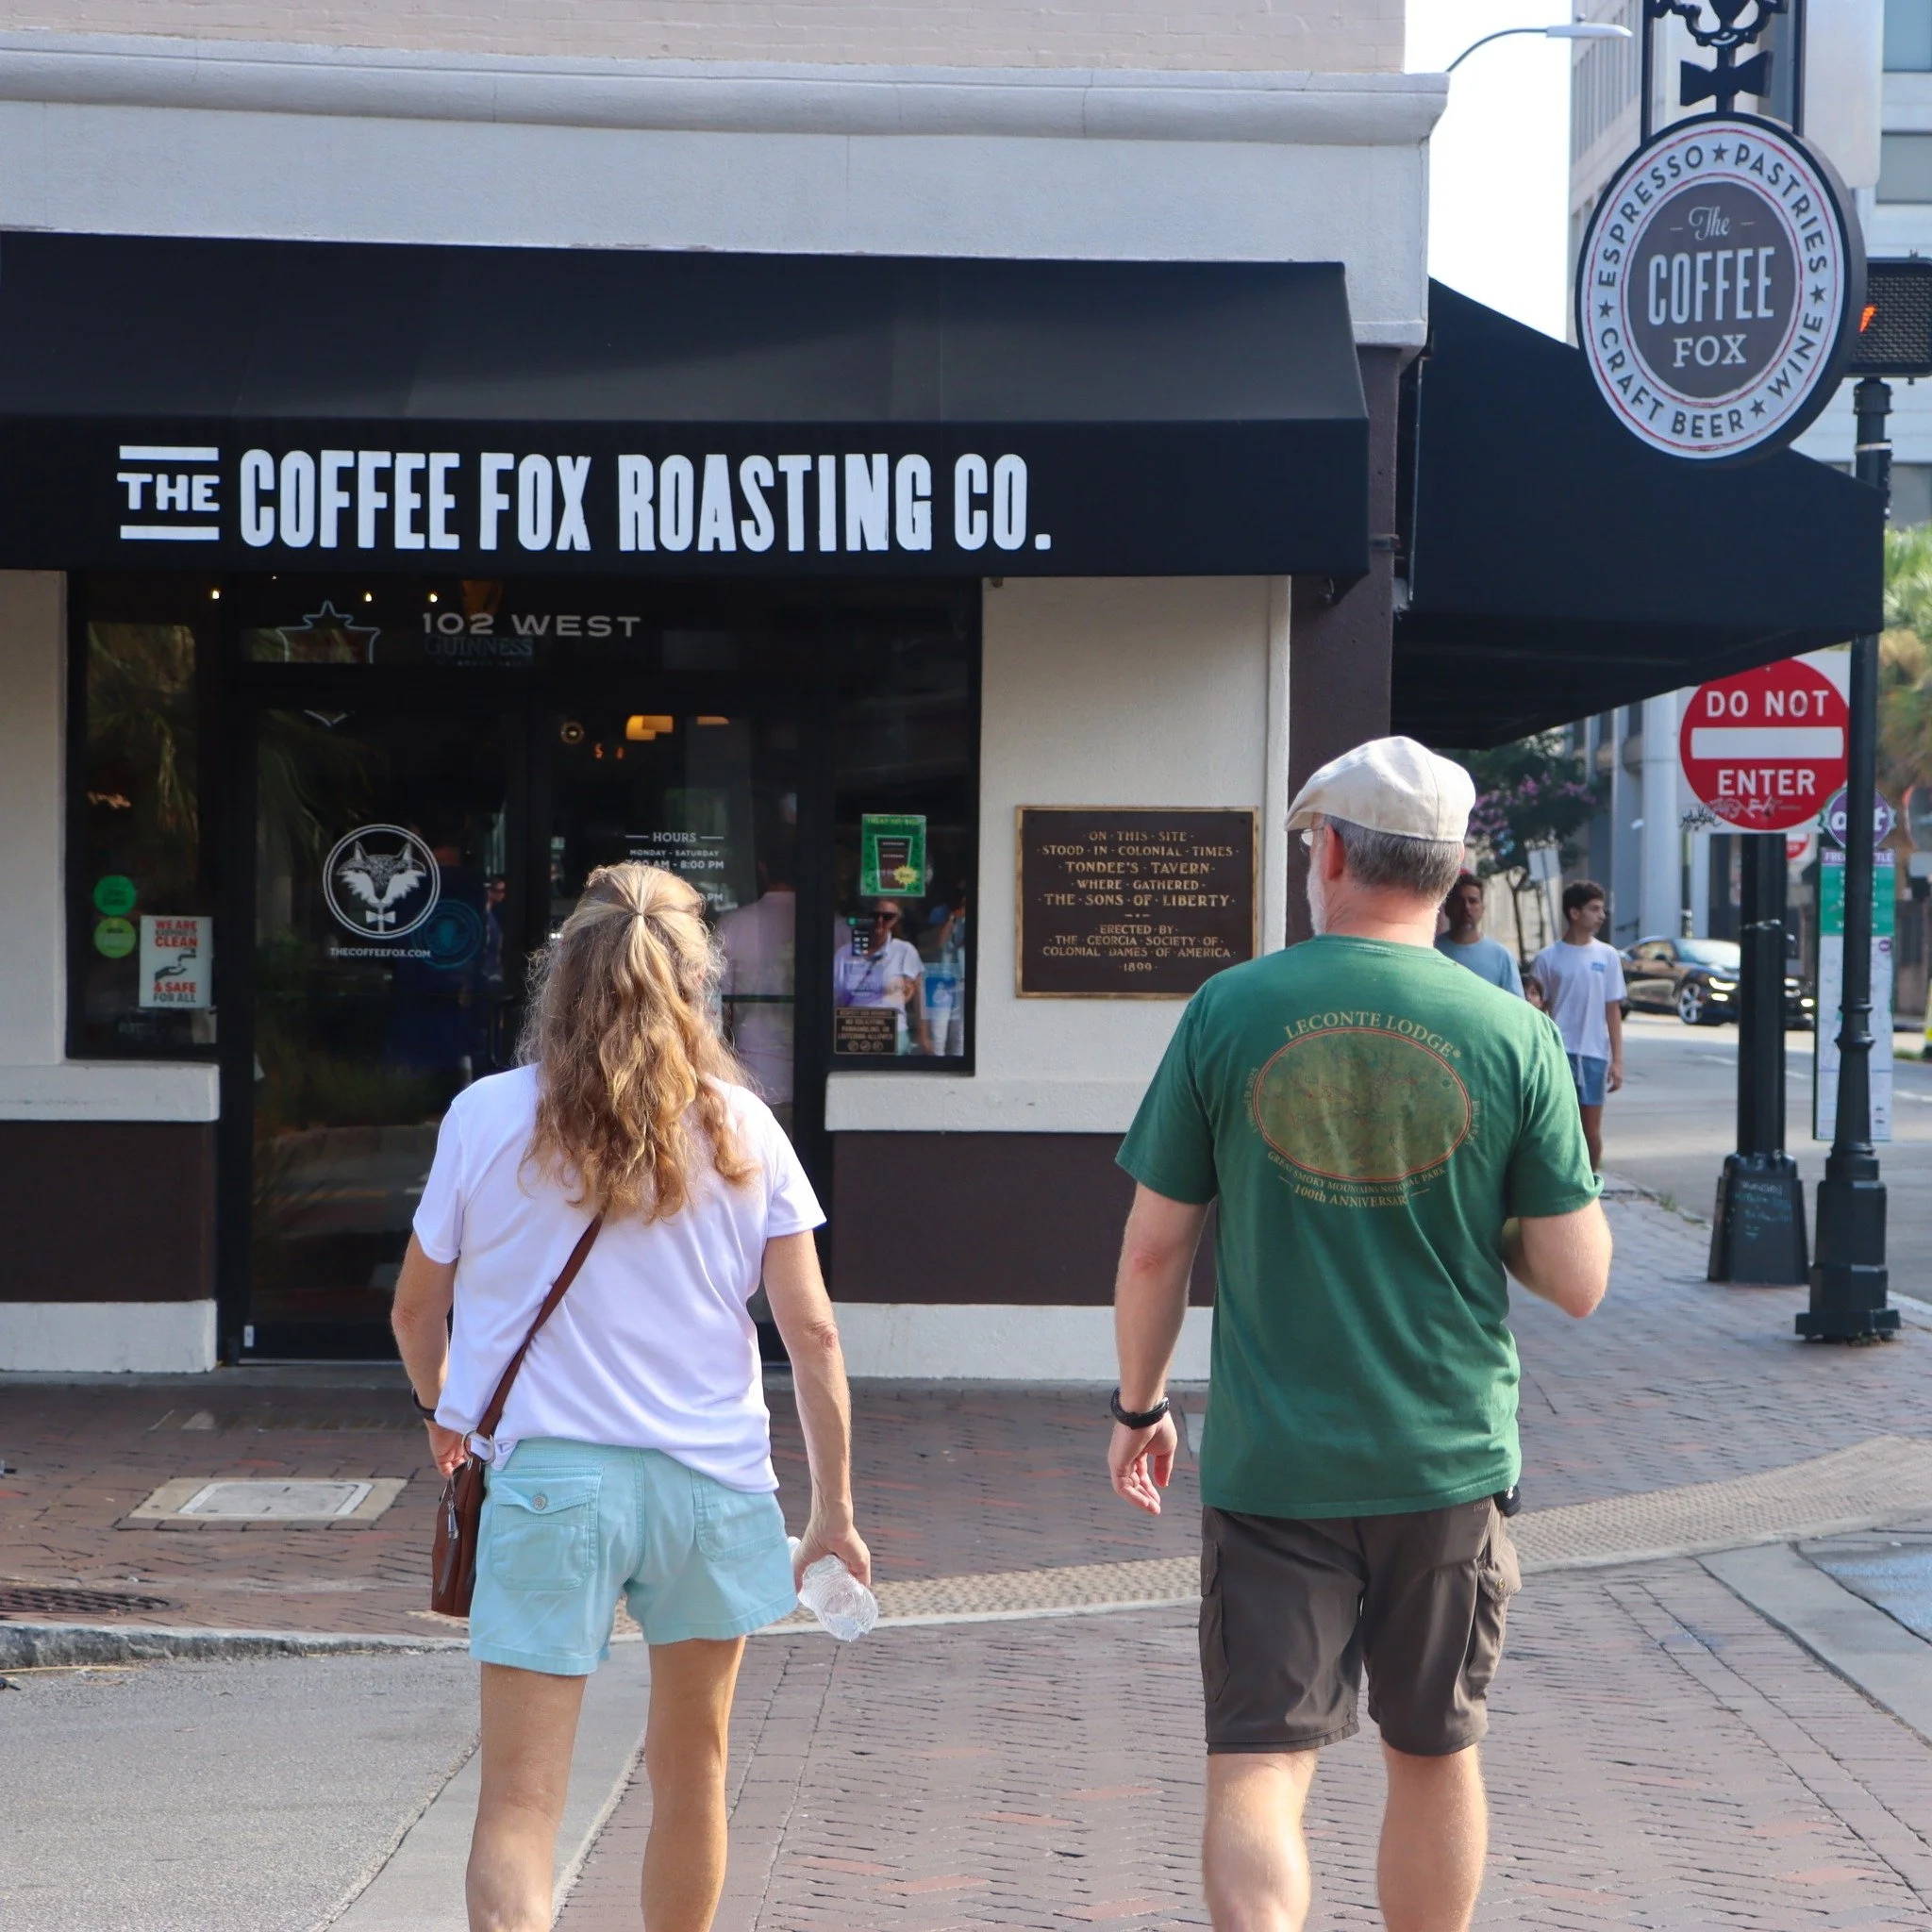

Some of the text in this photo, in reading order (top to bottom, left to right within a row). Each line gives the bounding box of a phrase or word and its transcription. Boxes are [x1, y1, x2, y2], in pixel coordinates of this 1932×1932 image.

[1735, 142, 1828, 274] PASTRIES
[1598, 143, 1704, 288] ESPRESSO
[1688, 206, 1730, 242] The
[1647, 246, 1776, 325] COFFEE
[1673, 333, 1747, 368] FOX
[1767, 312, 1824, 399] WINE
[1600, 326, 1745, 439] CRAFT BEER
[117, 448, 1053, 553] THE COFFEE FOX ROASTING CO.
[422, 611, 642, 638] 102 WEST
[422, 634, 535, 658] GUINNESS
[1706, 689, 1830, 718] DO NOT
[1717, 768, 1817, 796] ENTER
[652, 831, 698, 843] HOURS
[1089, 830, 1188, 842] ON THIS SITE
[1042, 845, 1234, 857] STOOD IN COLONIAL TIMES
[680, 860, 706, 870] 8:00
[708, 860, 724, 870] PM
[1065, 861, 1210, 874] TONDEE'S TAVERN
[1076, 879, 1199, 891] WHERE GATHERED
[707, 892, 724, 902] PM
[1043, 893, 1230, 908] THE SONS OF LIBERTY
[155, 920, 197, 930] WE ARE
[1099, 924, 1174, 935] ERECTED BY
[155, 936, 198, 948] CLEAN
[1055, 935, 1219, 946] THE GEORGIA SOCIETY OF
[330, 947, 432, 958] THECOFFEEFOX.COM
[1042, 946, 1232, 958] COLONIAL DAMES OF AMERICA
[1123, 962, 1153, 972] 1899
[165, 982, 197, 993] SAFE
[154, 992, 197, 1004] FOR ALL
[1284, 1010, 1381, 1039] LECONTE
[1267, 1150, 1293, 1173] GREAT
[1292, 1169, 1326, 1188] SMOKY
[1327, 1181, 1379, 1194] MOUNTAINS
[1421, 1165, 1446, 1183] PARK
[1293, 1184, 1326, 1203] 100th
